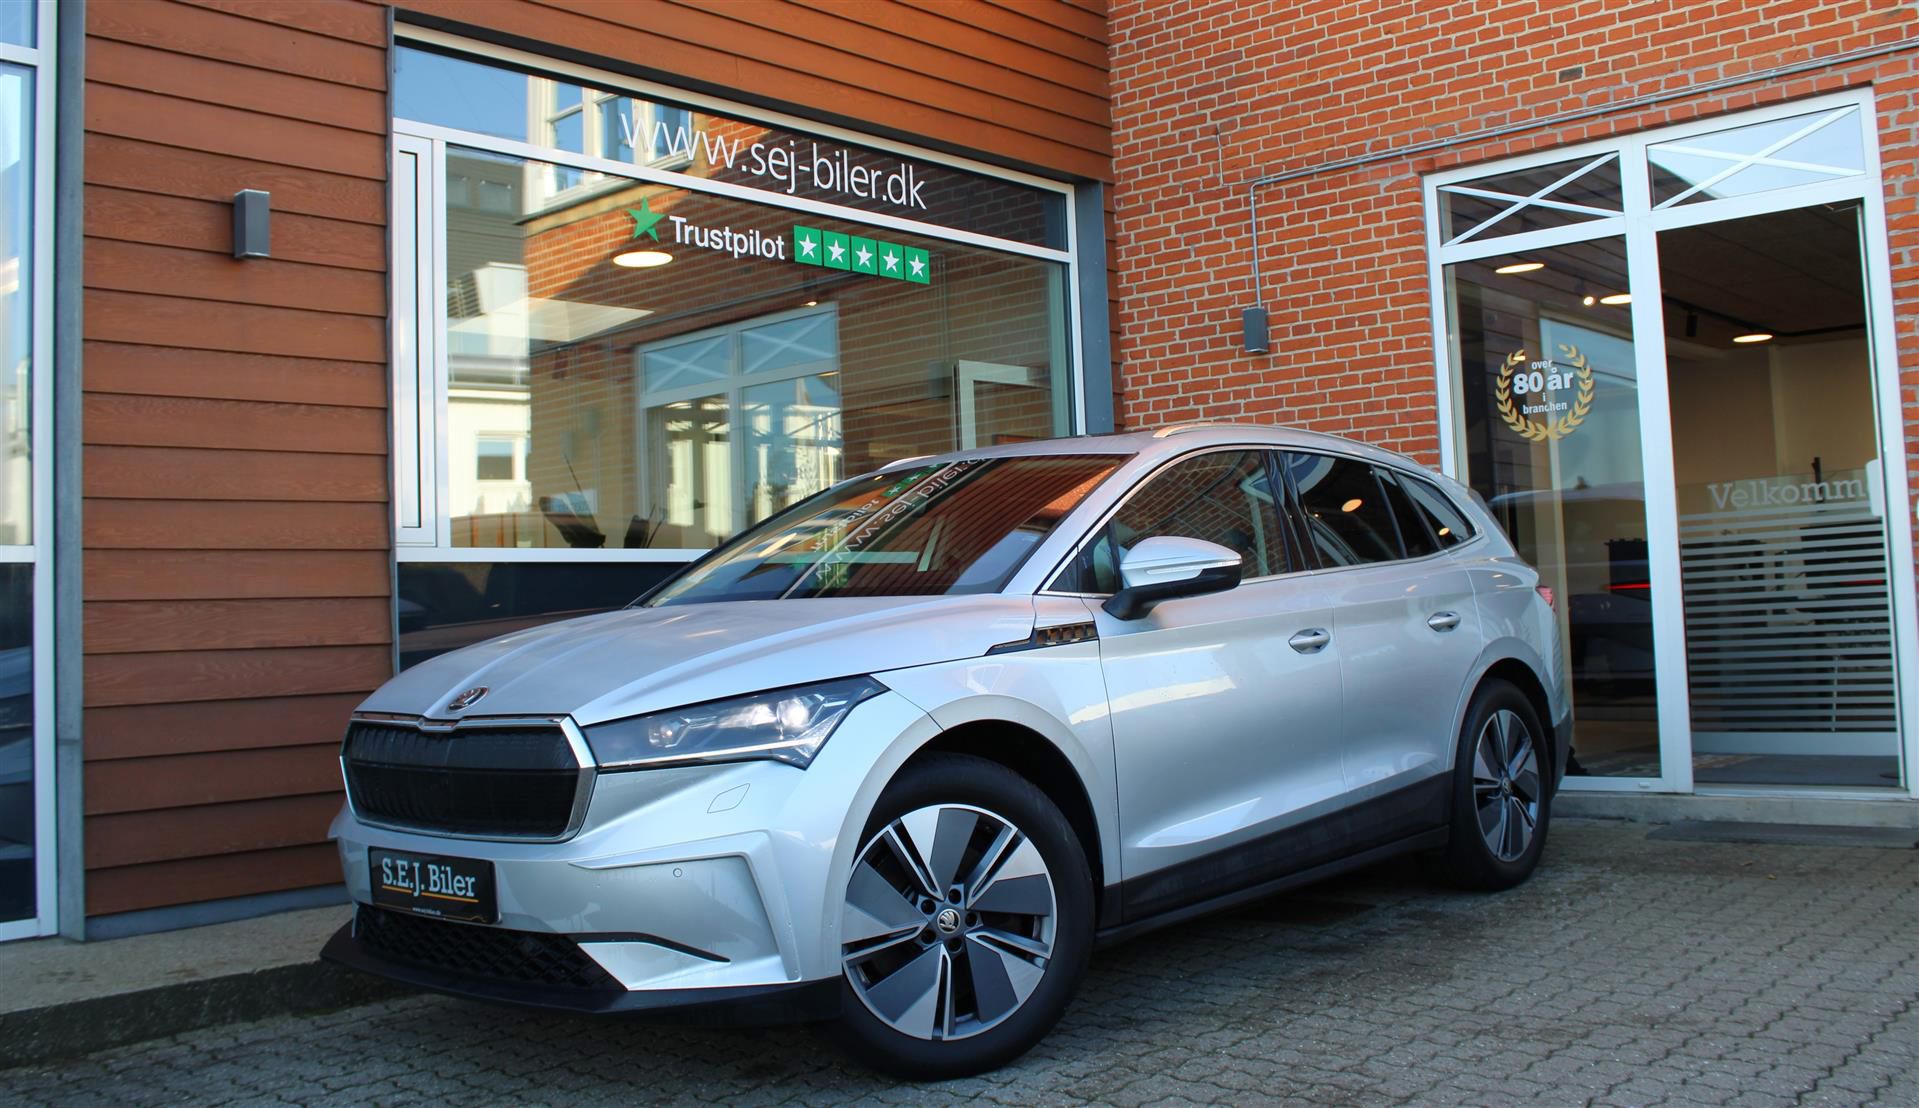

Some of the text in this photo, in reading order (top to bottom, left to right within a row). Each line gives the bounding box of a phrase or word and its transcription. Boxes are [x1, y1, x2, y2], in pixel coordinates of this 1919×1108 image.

[620, 113, 927, 210] www.sej-biler.dk
[669, 215, 786, 260] Trustpilot
[1513, 367, 1574, 394] 80 år
[1531, 360, 1552, 370] over
[1522, 401, 1568, 415] branchen
[382, 858, 476, 898] S.E.J. Biler
